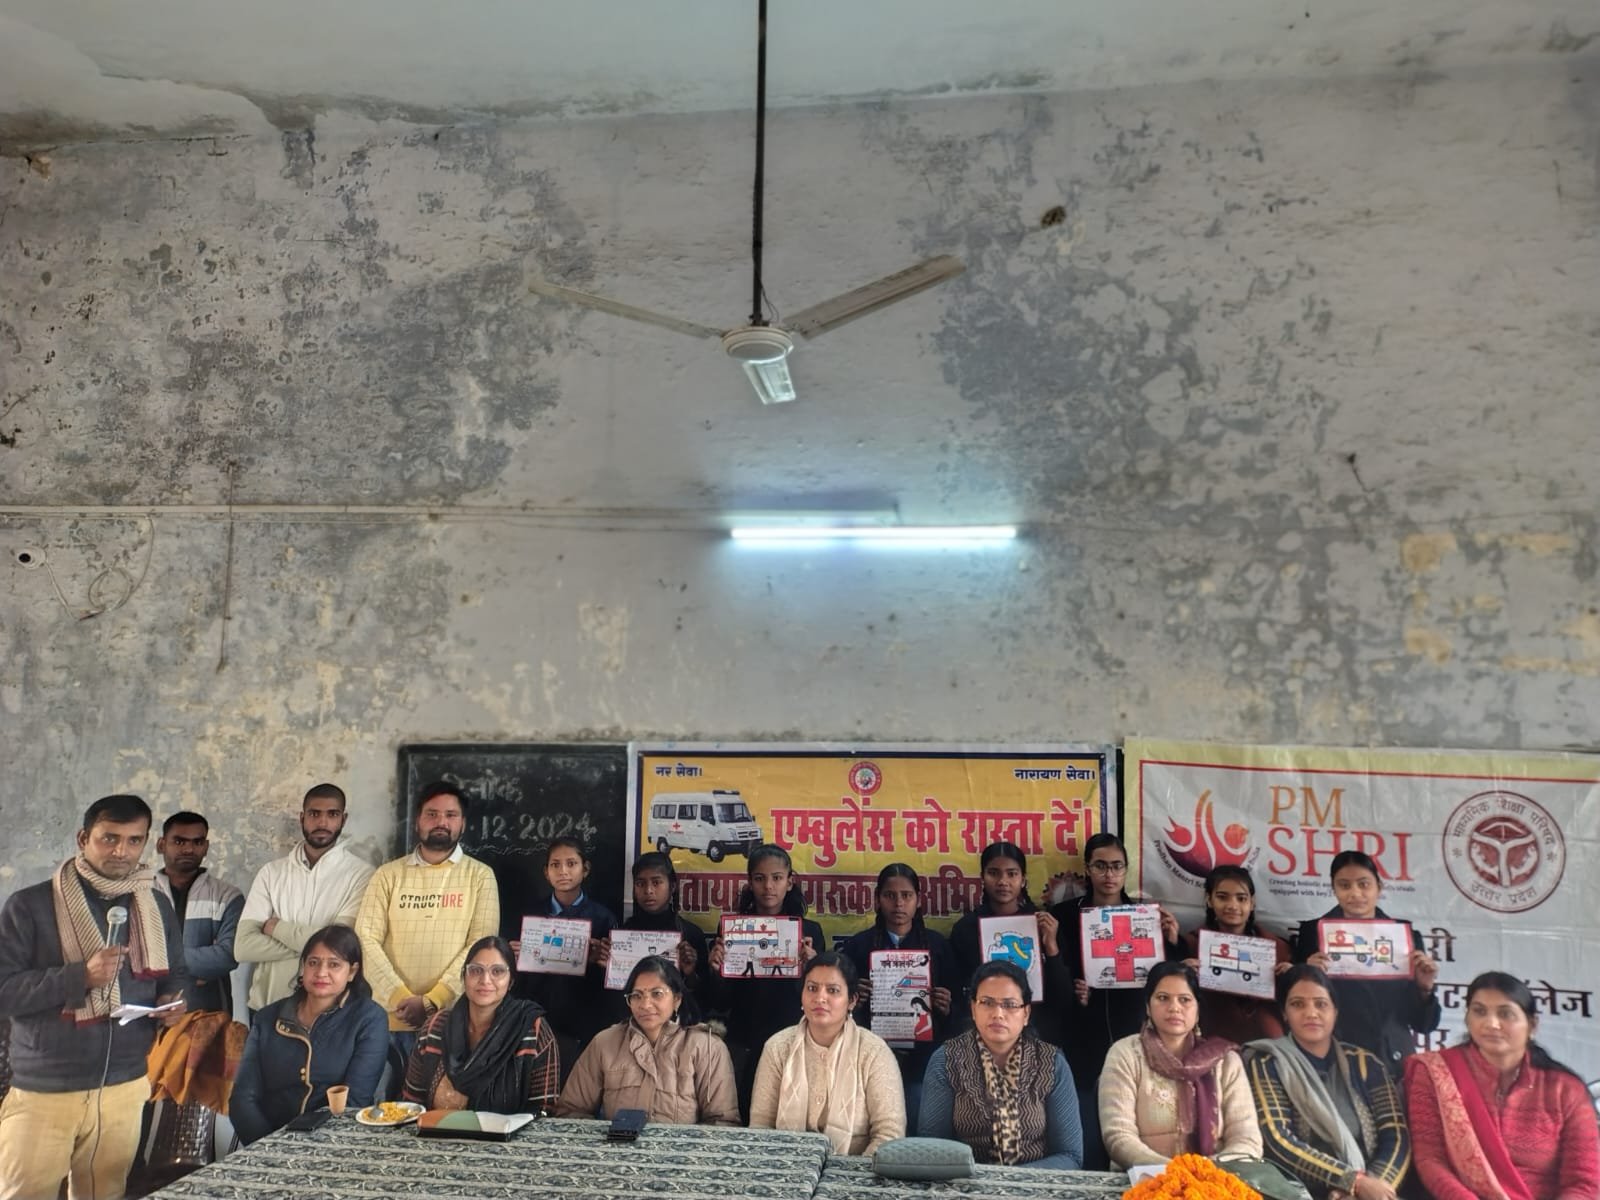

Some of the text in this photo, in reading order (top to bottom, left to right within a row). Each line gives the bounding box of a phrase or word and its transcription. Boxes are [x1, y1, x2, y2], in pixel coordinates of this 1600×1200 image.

[656, 766, 672, 777] नर
[1014, 769, 1061, 780] नारायण
[1268, 785, 1346, 828] PM
[771, 797, 897, 868] एम्बुलेंस
[902, 798, 952, 853] को
[957, 811, 1045, 855] रास्ता
[1268, 827, 1414, 881] SHRI
[399, 893, 464, 909] STRUCTURE
